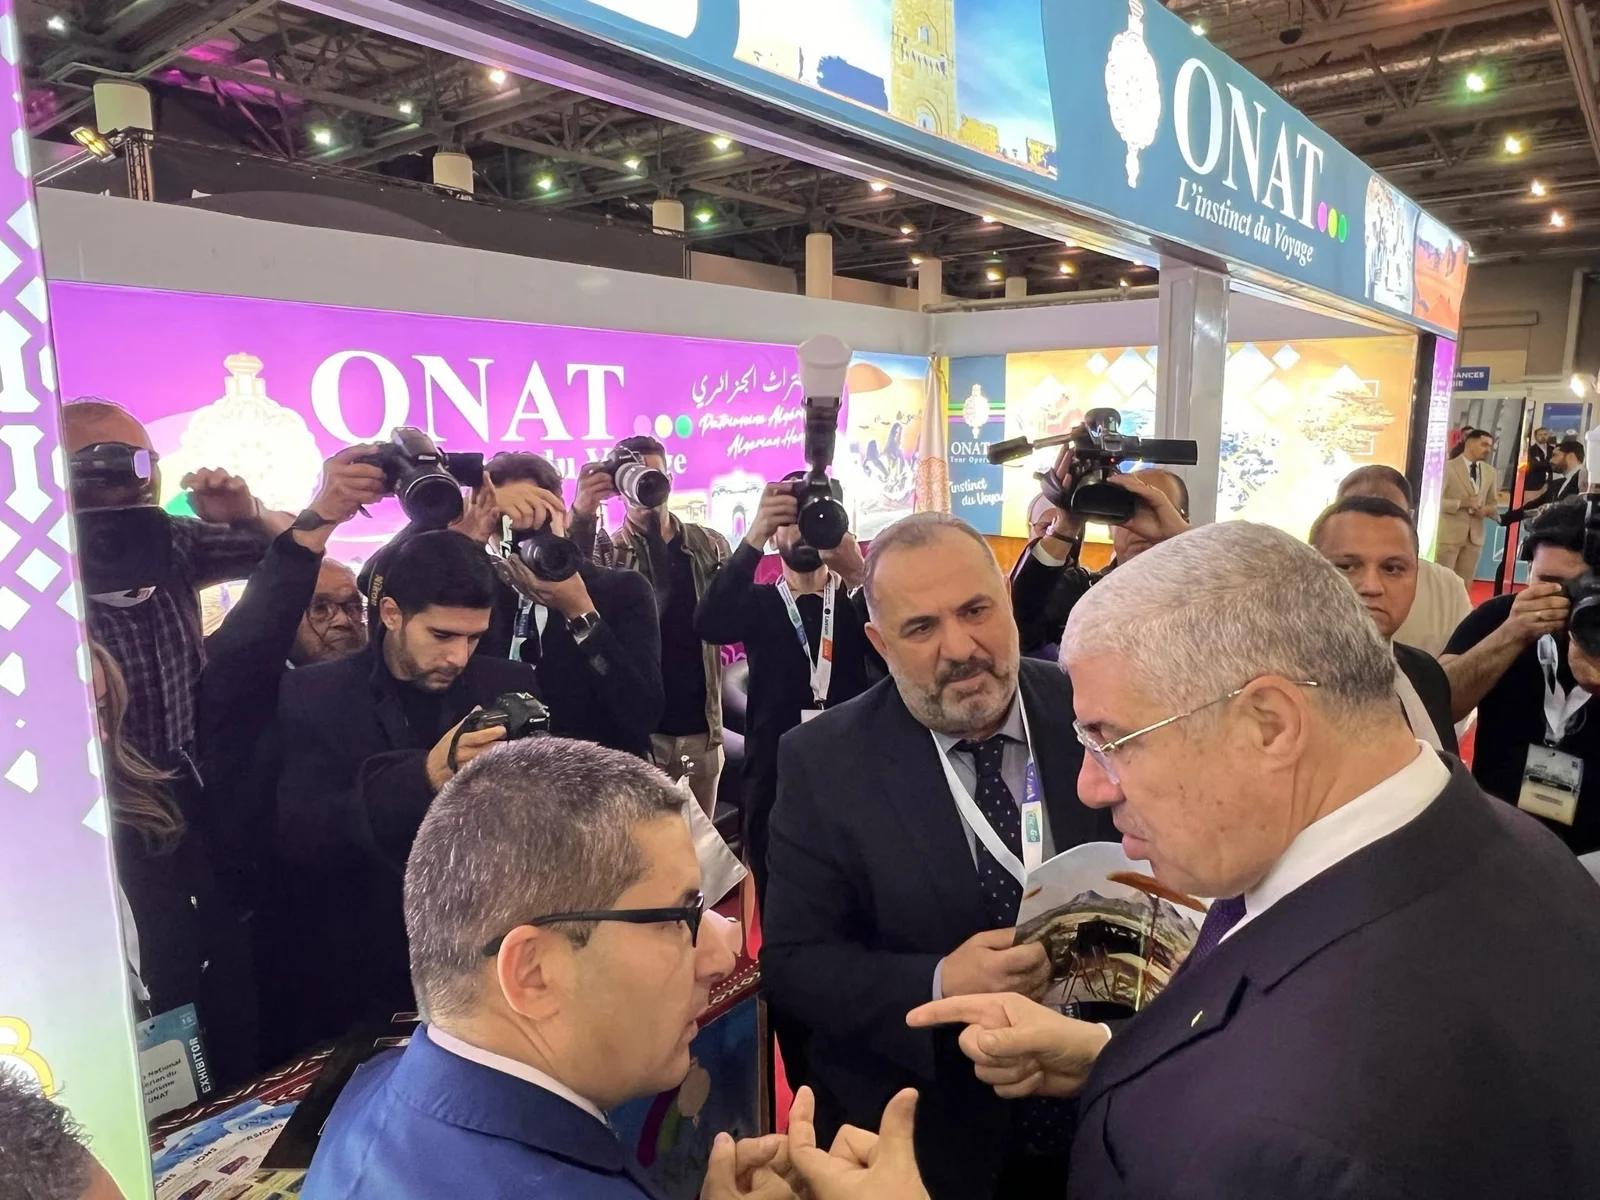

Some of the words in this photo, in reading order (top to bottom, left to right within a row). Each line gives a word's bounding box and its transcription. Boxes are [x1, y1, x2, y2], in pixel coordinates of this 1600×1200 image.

[1173, 57, 1324, 230] ONAT
[1175, 177, 1252, 236] L'instinct
[1253, 219, 1271, 245] du
[1274, 223, 1314, 266] Voyage
[310, 350, 625, 444] ONAT
[951, 441, 989, 454] ONAT
[962, 495, 975, 506] du
[147, 1058, 182, 1078] National
[189, 1036, 212, 1094] EXHIBITOR
[246, 1123, 285, 1142] RSIONS
